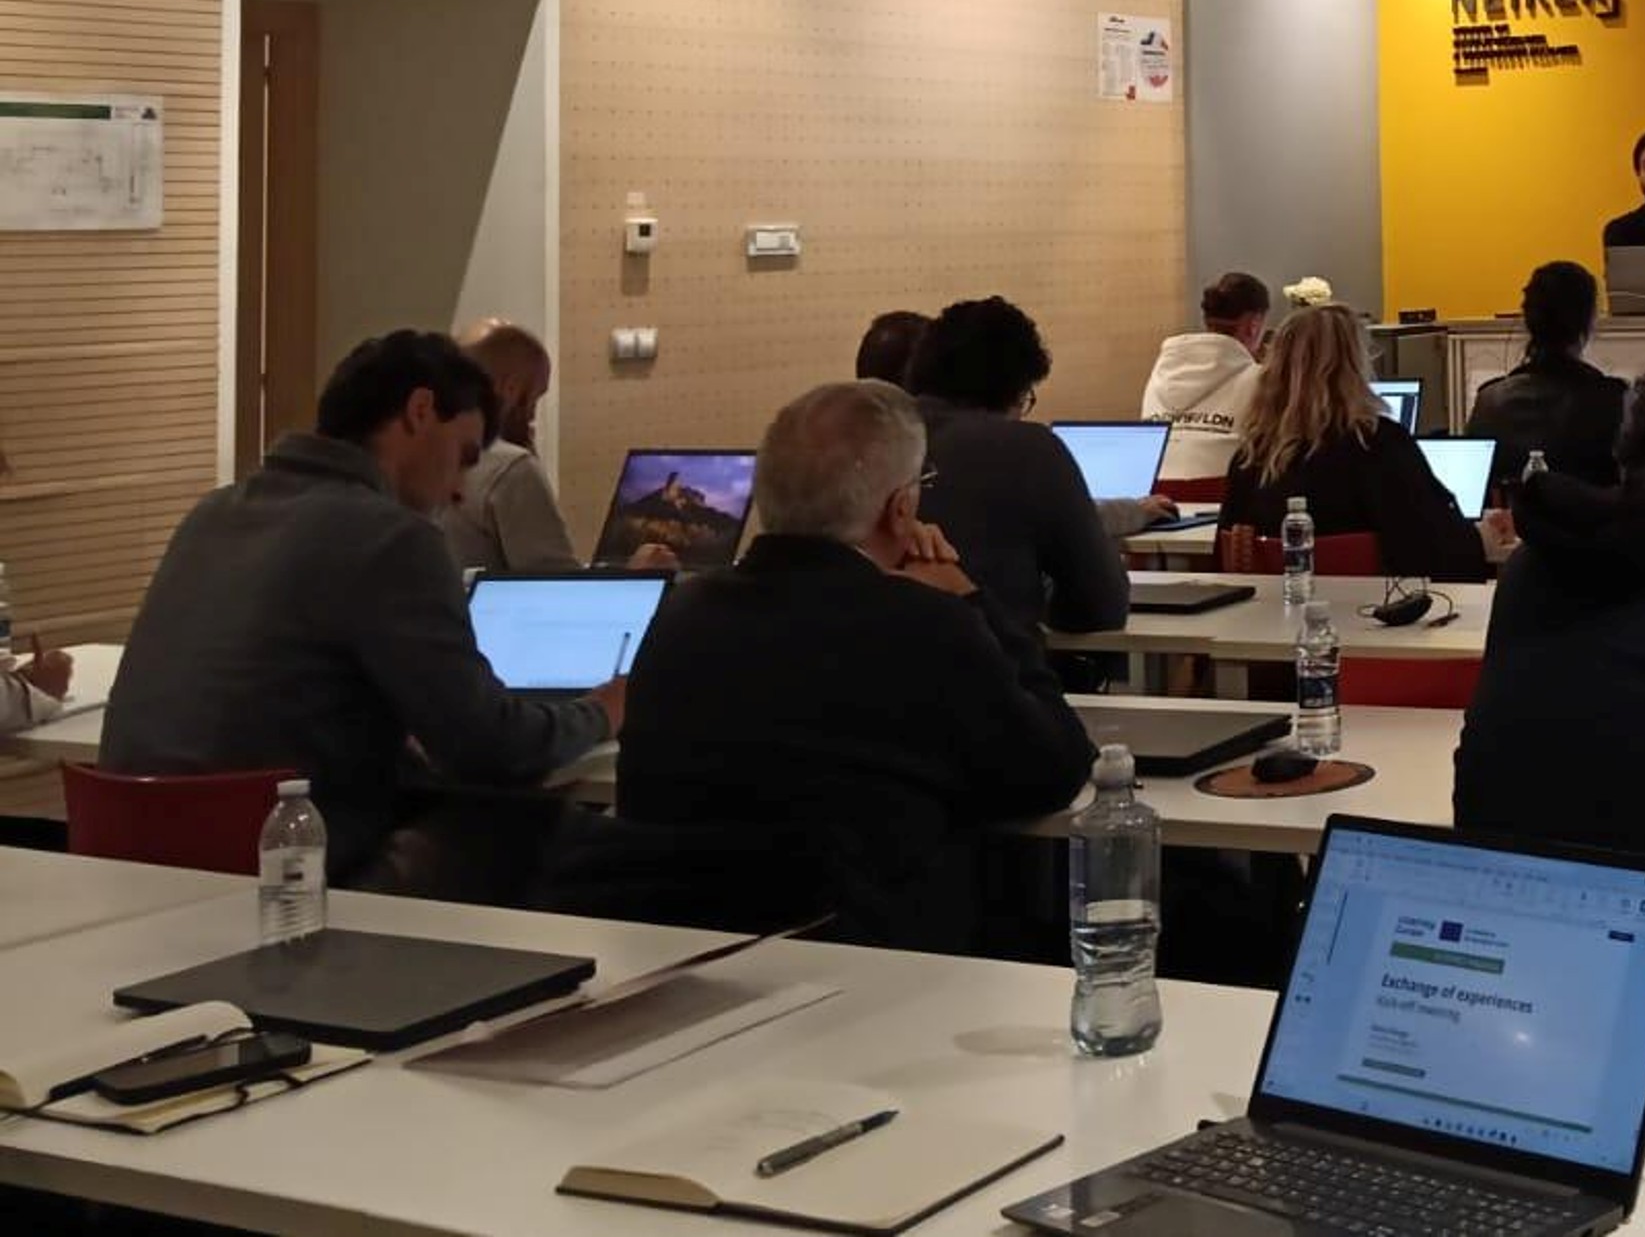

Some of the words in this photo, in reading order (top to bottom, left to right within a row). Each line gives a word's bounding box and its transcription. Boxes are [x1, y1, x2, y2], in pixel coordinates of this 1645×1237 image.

[1381, 973, 1439, 999] Exchange
[1441, 985, 1456, 999] of
[1456, 990, 1533, 1014] experiences
